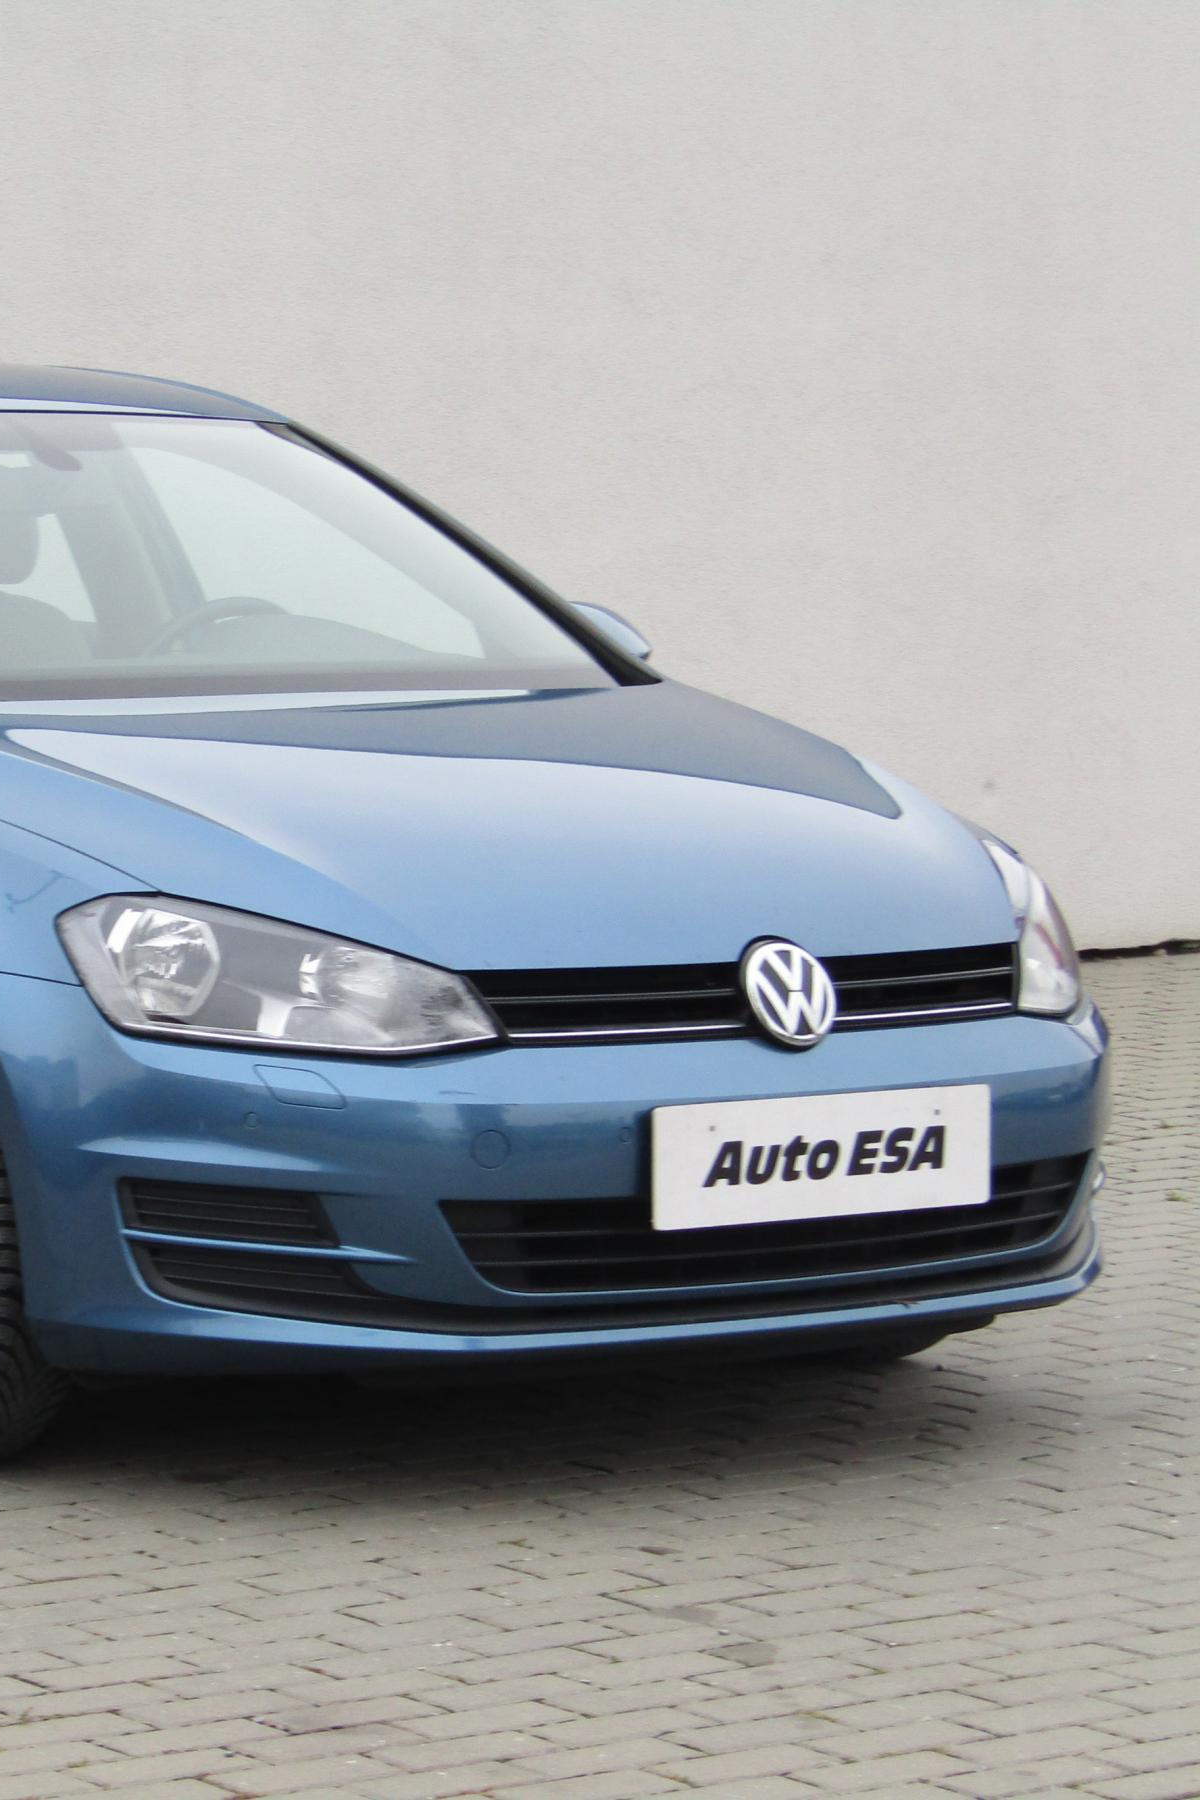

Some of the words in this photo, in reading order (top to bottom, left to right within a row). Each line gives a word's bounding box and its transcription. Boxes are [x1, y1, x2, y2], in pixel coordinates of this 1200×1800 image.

[746, 943, 835, 1045] VW
[702, 1135, 841, 1188] Auto
[846, 1125, 946, 1177] ESA
